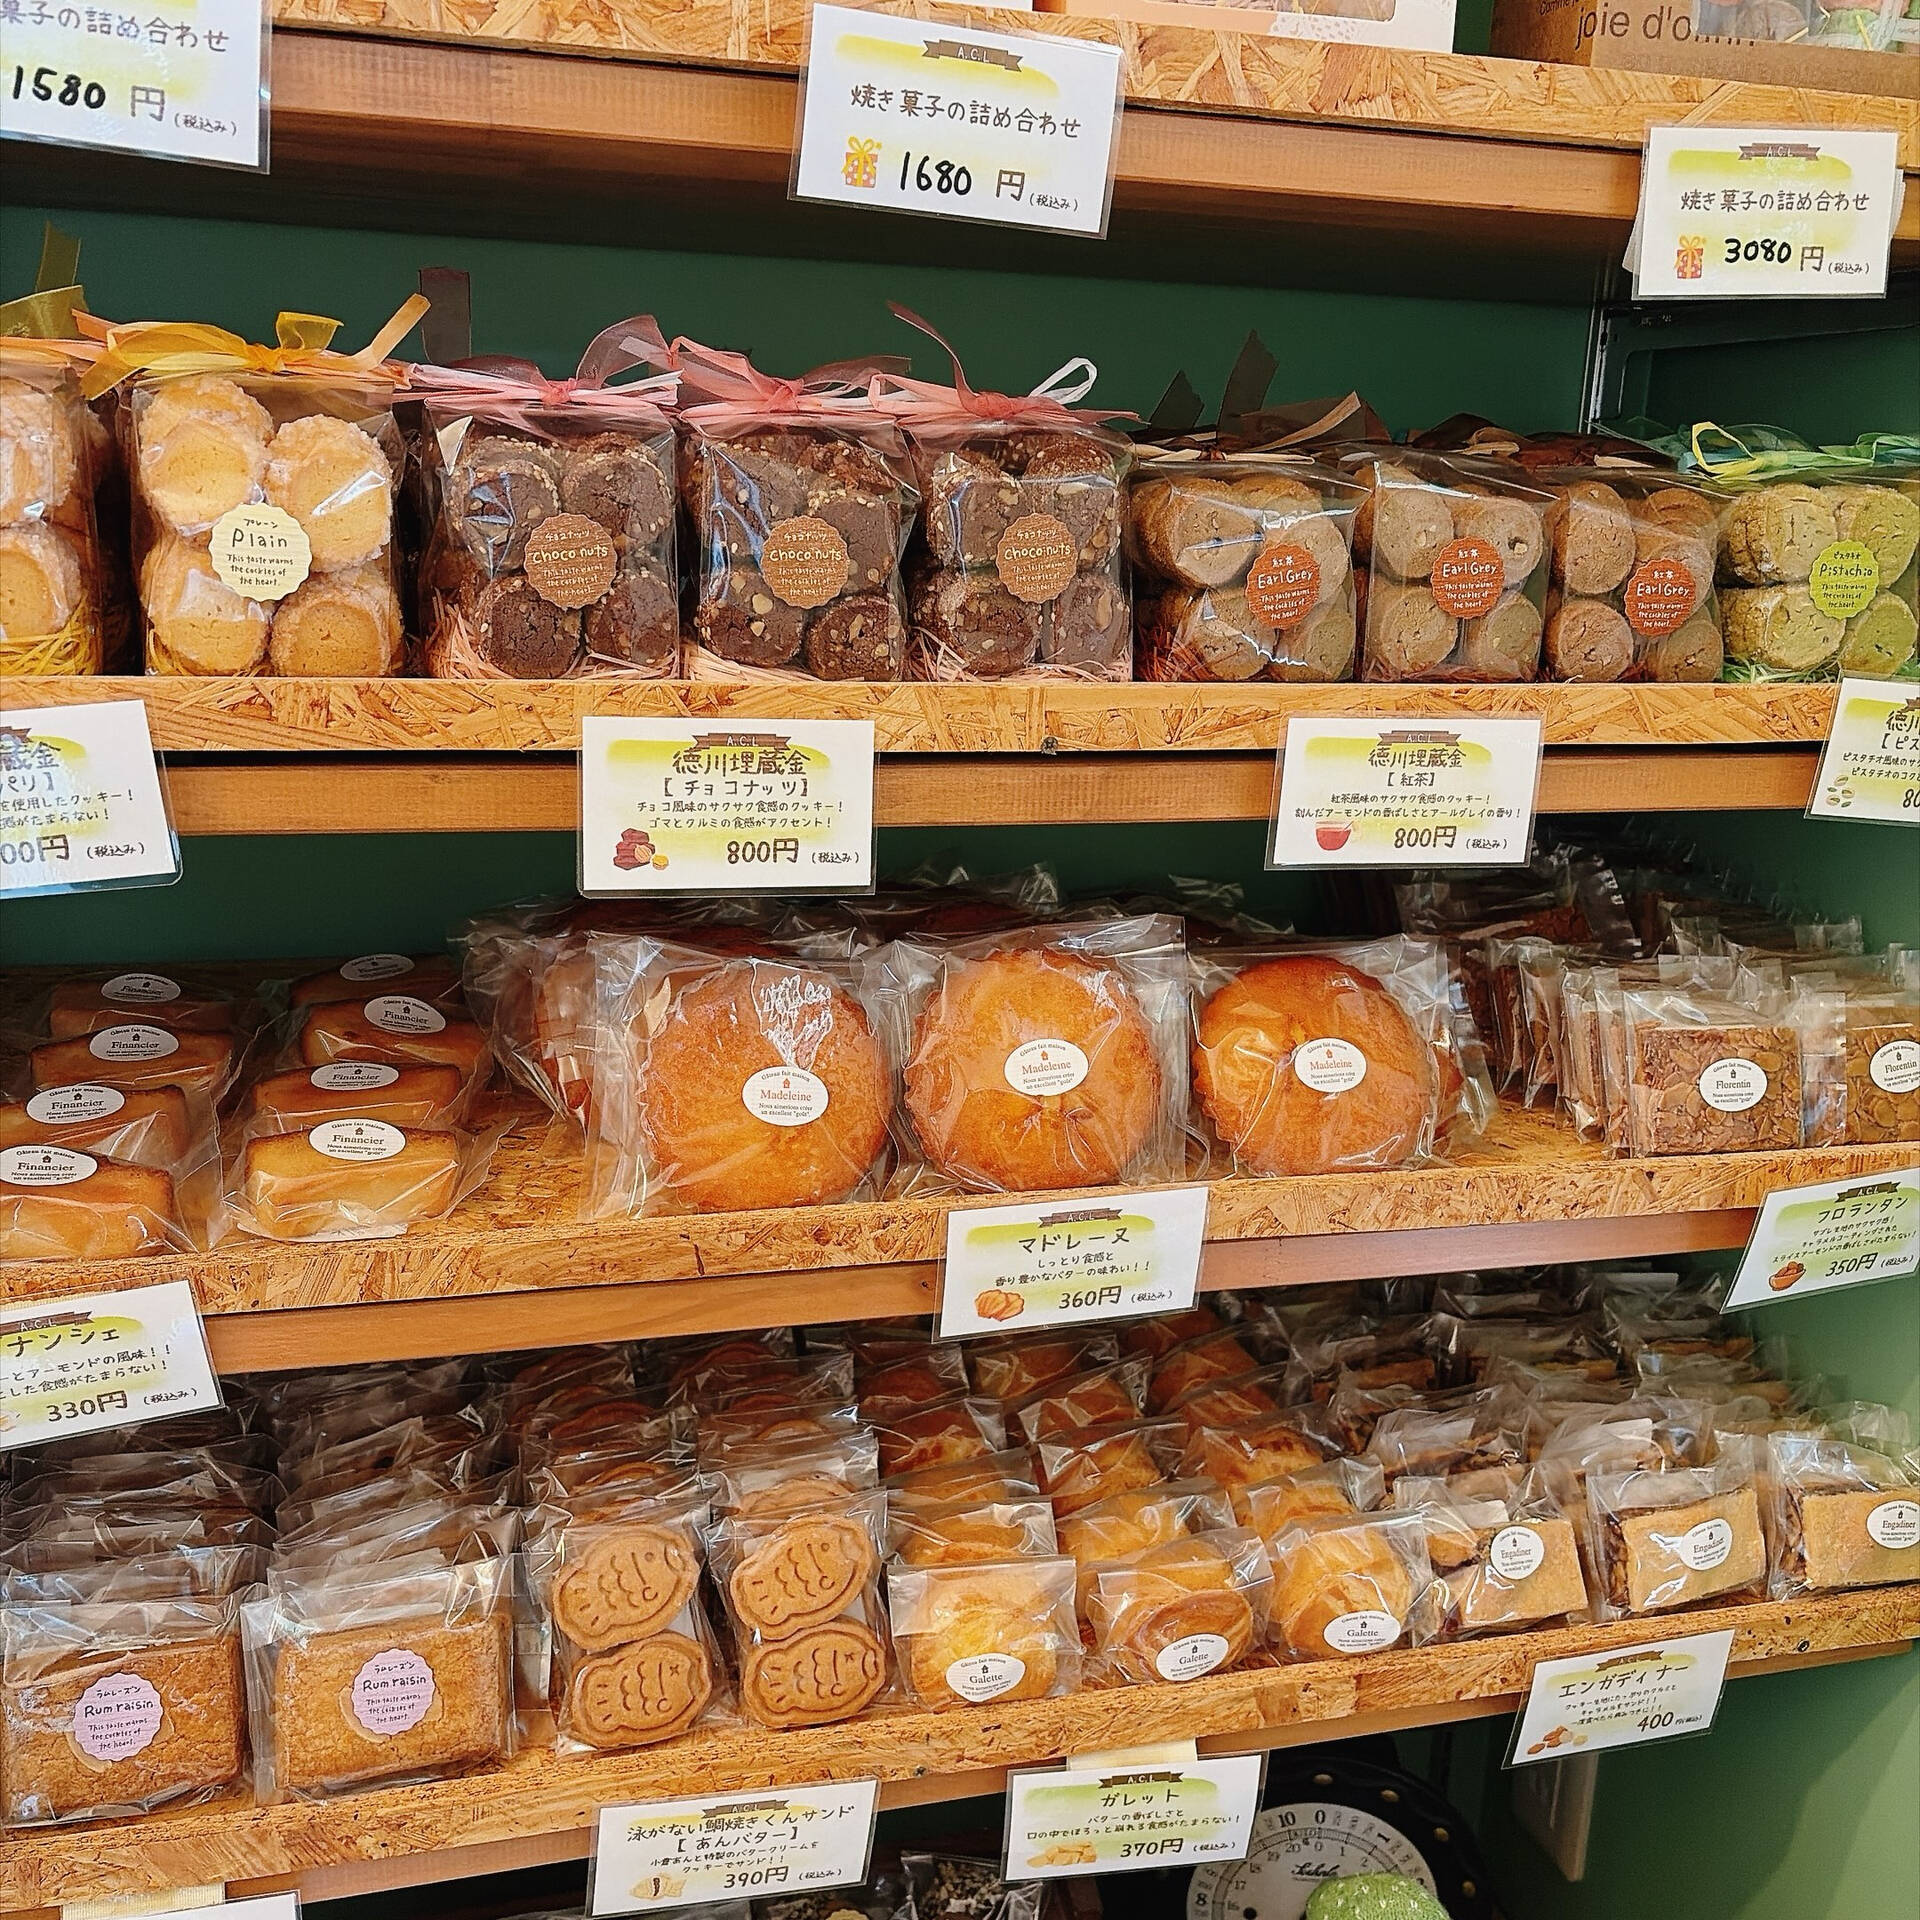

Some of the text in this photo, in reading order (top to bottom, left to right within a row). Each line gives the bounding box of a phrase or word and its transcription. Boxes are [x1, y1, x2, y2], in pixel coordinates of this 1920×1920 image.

[1575, 3, 1630, 50] joie
[13, 65, 106, 109] 1580
[130, 85, 165, 122] 円
[900, 151, 972, 195] 1680
[996, 169, 1025, 201] 円
[1723, 237, 1792, 264] 3080
[1800, 246, 1825, 273] 円
[232, 527, 288, 548] Plain
[580, 544, 608, 558] nuts
[815, 548, 841, 561] nuts
[1046, 542, 1071, 555] nuts
[225, 553, 294, 566] This taste warms
[231, 565, 244, 574] the
[278, 568, 287, 577] of
[1443, 562, 1497, 577] Earl Grey
[1819, 563, 1873, 577] Pistachio
[240, 576, 253, 585] the
[1258, 569, 1313, 589] Earl Grey
[1637, 583, 1689, 597] Earl Grey
[672, 749, 812, 777] 徳川埋蔵金
[1368, 747, 1467, 769] 徳川埋蔵金
[1393, 825, 1457, 849] 800円
[726, 837, 800, 865] 800円
[384, 1010, 429, 1025] Financier
[111, 1041, 160, 1050] Financier
[1022, 1061, 1072, 1075] Madeleine
[1309, 1060, 1352, 1071] Madeleine
[1884, 1060, 1918, 1074] Florentin
[332, 1073, 380, 1081] Financier
[1716, 1080, 1751, 1090] Florentin
[760, 1089, 812, 1101] Madeleine
[51, 1099, 105, 1110] Financier
[332, 1134, 385, 1145] Financier
[17, 1162, 76, 1173] Financier
[1818, 1197, 1909, 1224] フロランタン
[1018, 1227, 1130, 1255] マドレーヌ
[1037, 1251, 1114, 1269] しっとり食感と
[1825, 1252, 1879, 1277] 350円
[1058, 1285, 1122, 1310] 360円
[46, 1390, 128, 1422] 330円
[1347, 1629, 1379, 1637] Galette
[1179, 1653, 1209, 1664] Galette
[362, 1676, 426, 1693] Rum raisin
[969, 1674, 1003, 1684] Galette
[1558, 1663, 1689, 1699] エンガディナー
[84, 1700, 154, 1718] Rum raisin
[1637, 1711, 1674, 1733] 400
[1101, 1788, 1180, 1808] ガレット
[627, 1804, 855, 1843] 泳がない鯛焼きくんサンド
[1278, 1810, 1296, 1828] 10
[1314, 1809, 1326, 1825] 0
[1120, 1837, 1183, 1858] 370円
[723, 1865, 789, 1890] 390円
[1195, 1892, 1207, 1906] 8
